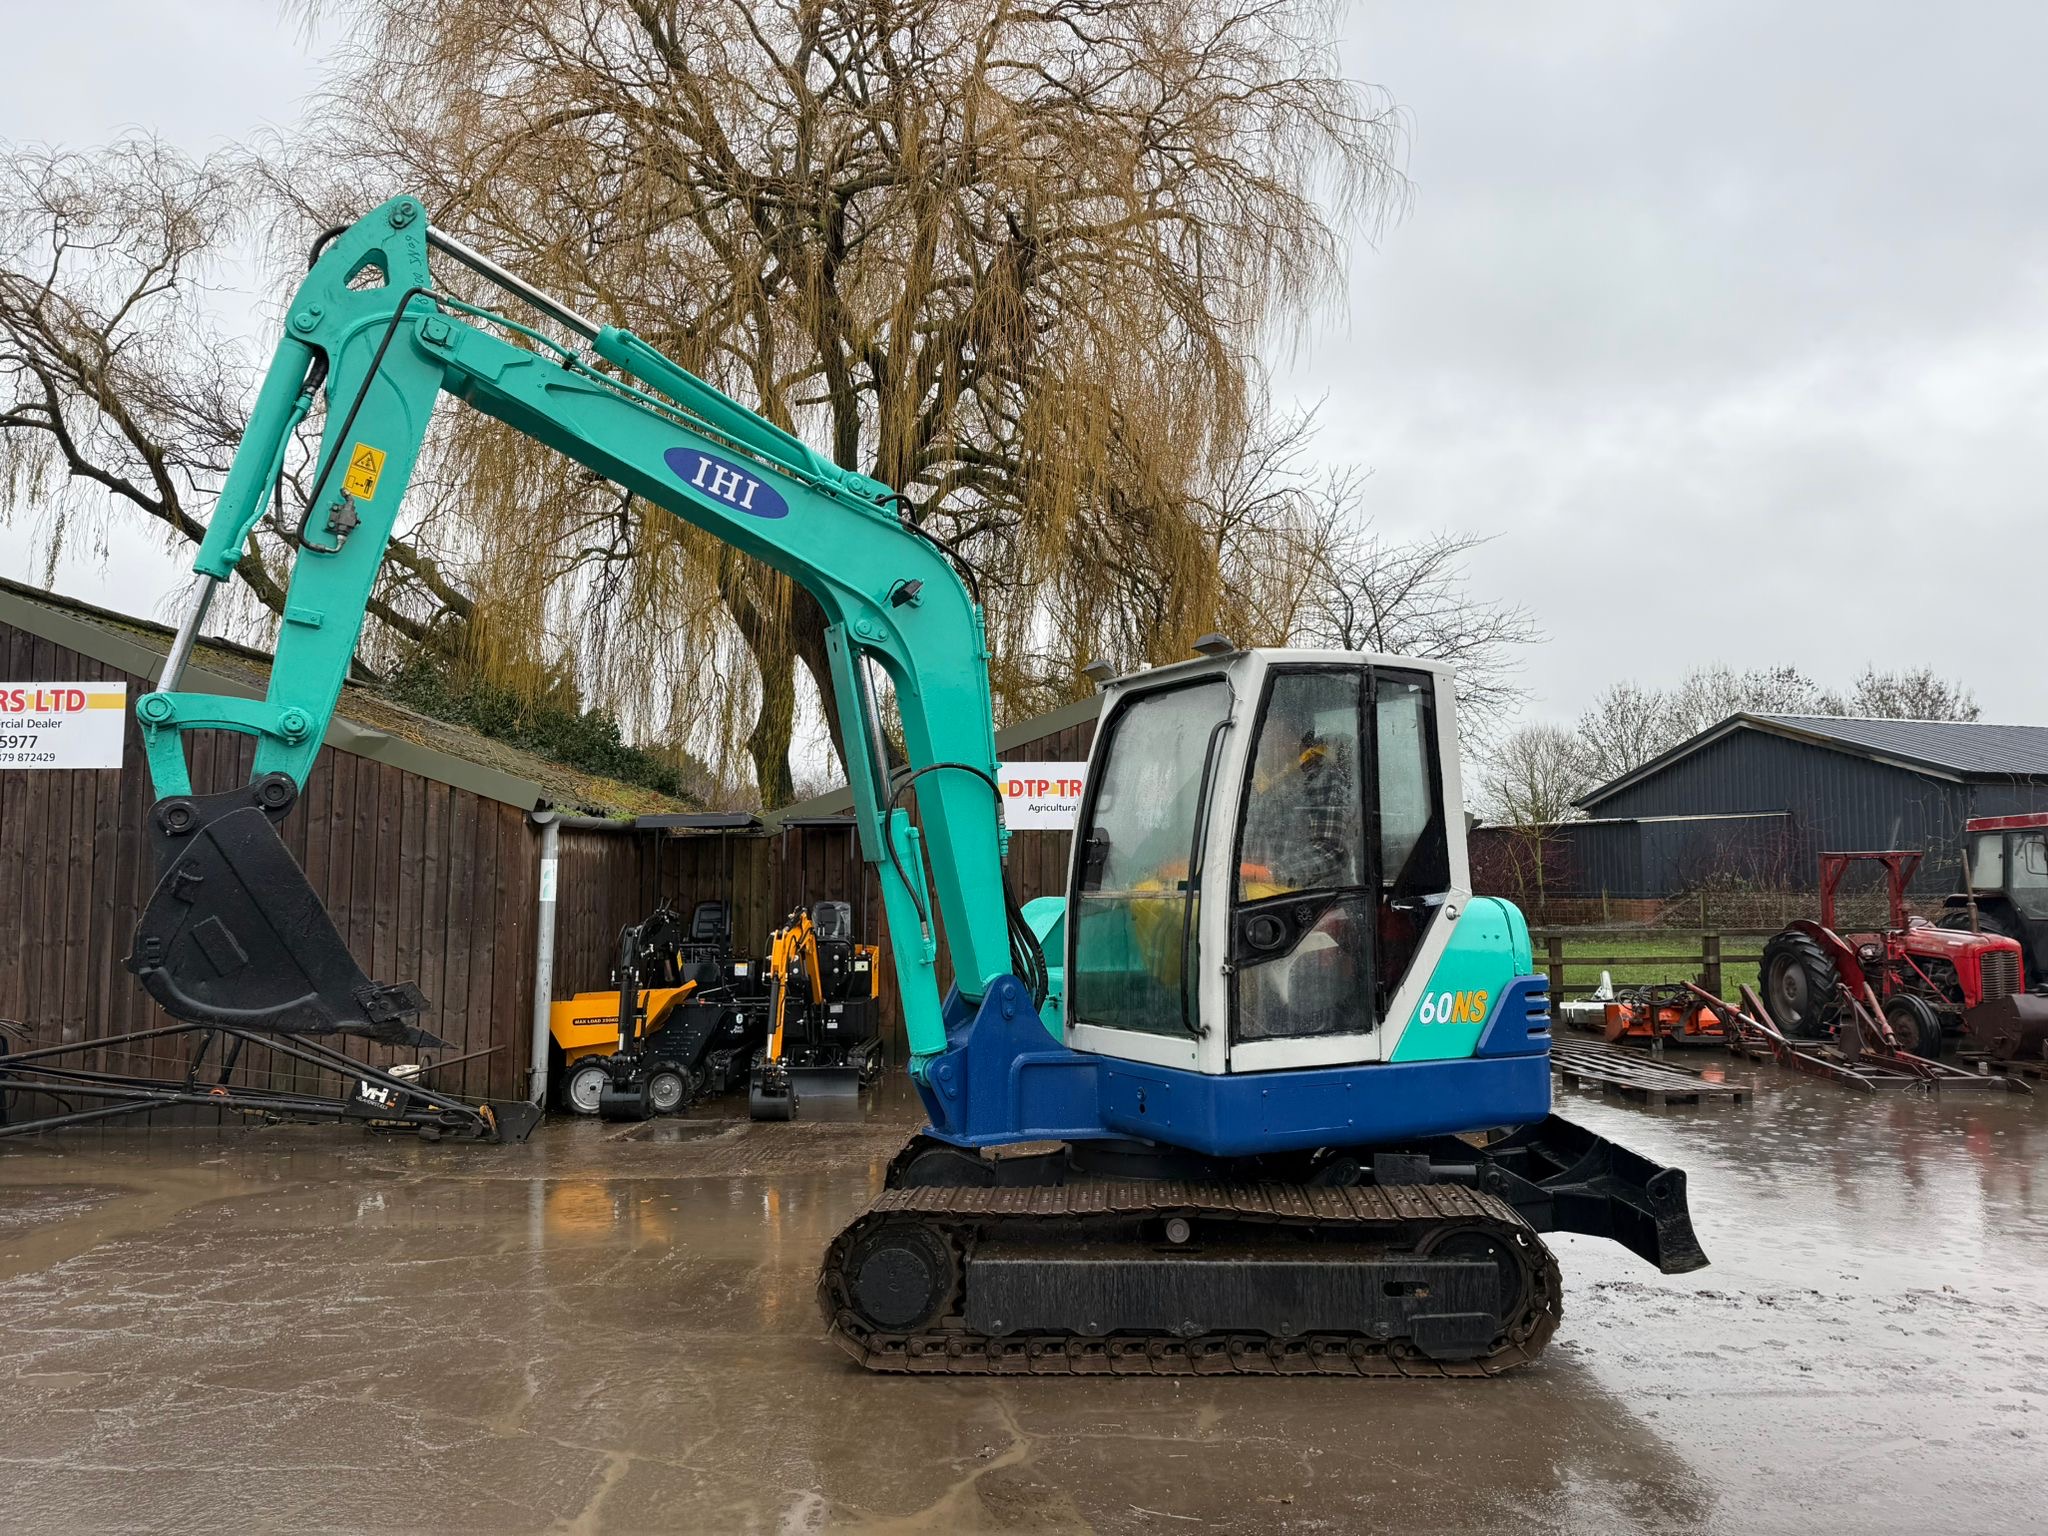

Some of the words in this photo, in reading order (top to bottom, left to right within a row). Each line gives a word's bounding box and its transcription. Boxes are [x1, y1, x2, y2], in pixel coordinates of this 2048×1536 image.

[691, 456, 759, 510] IHI
[36, 690, 85, 712] LTD
[27, 719, 62, 729] Dealer
[0, 735, 38, 748] 5977
[17, 753, 55, 762] 872429
[1009, 780, 1050, 797] DTP
[1057, 780, 1082, 797] TR
[1028, 803, 1078, 813] Agricultura
[1420, 990, 1488, 1024] 60NS
